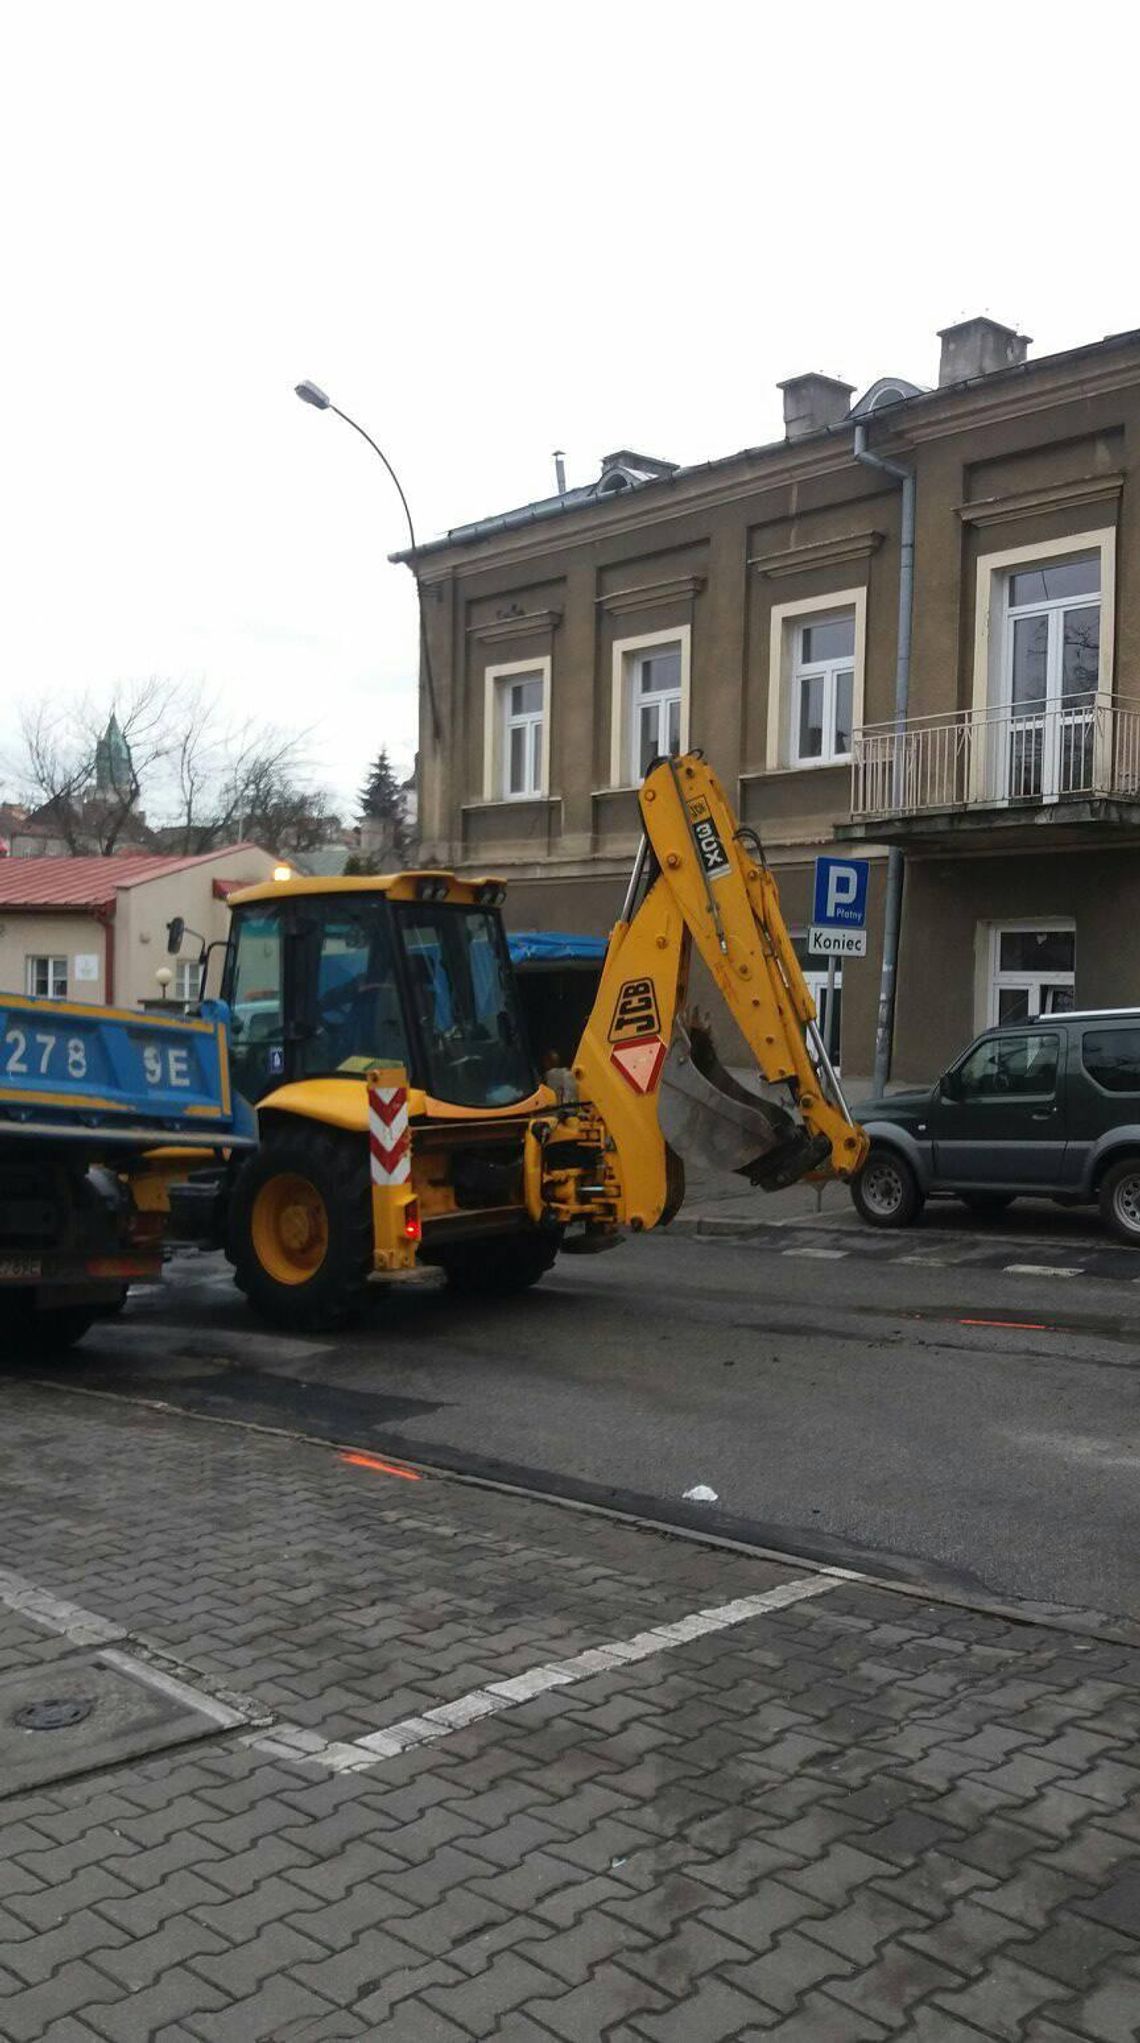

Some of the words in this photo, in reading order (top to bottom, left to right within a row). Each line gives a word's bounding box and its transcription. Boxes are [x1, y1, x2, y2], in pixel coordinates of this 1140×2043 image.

[826, 865, 858, 918] P
[813, 932, 862, 951] Koniec
[614, 981, 656, 1033] JCB
[5, 1029, 87, 1078] 278
[143, 1045, 191, 1087] 9E
